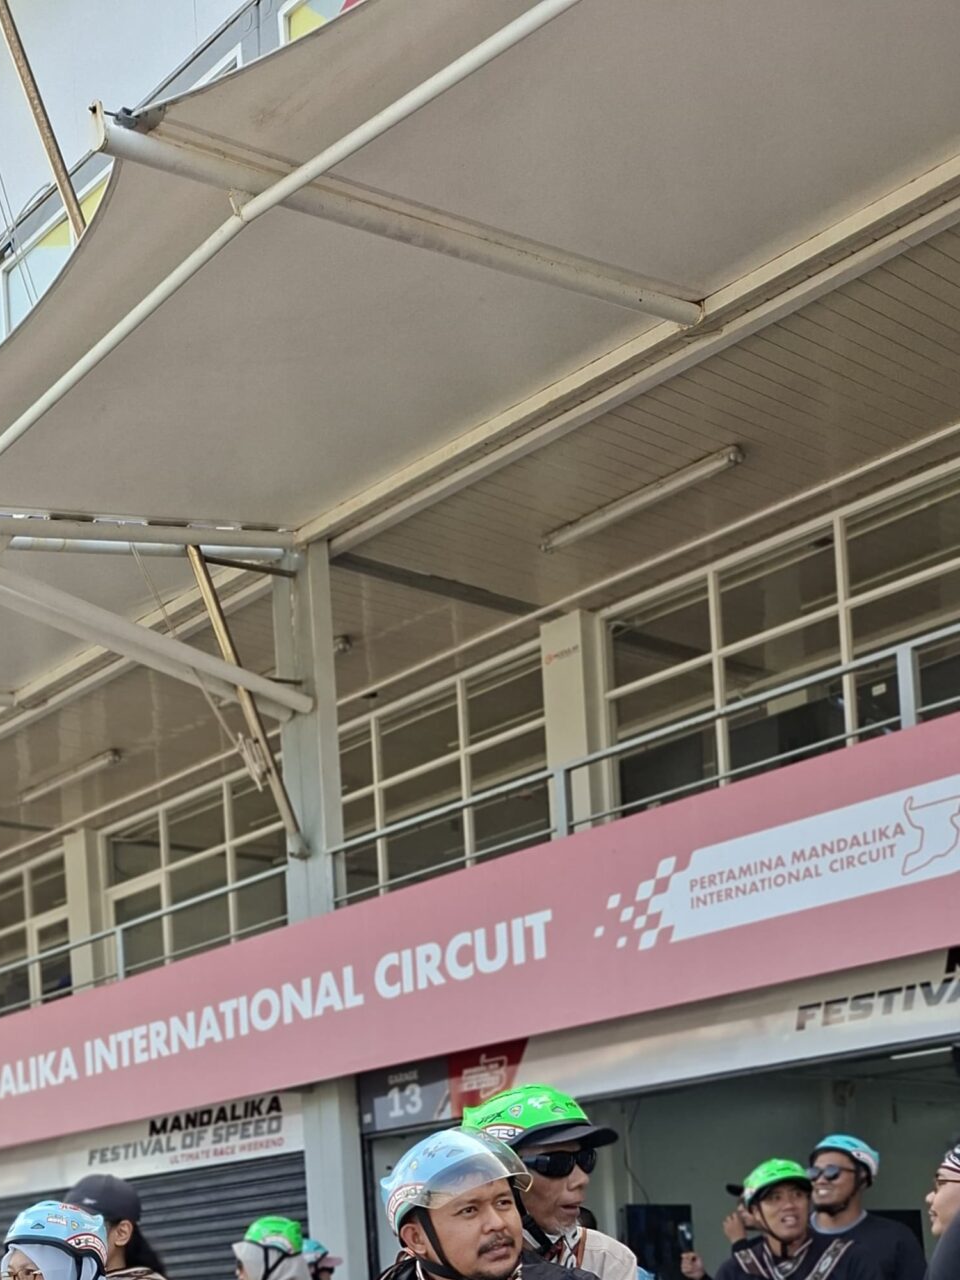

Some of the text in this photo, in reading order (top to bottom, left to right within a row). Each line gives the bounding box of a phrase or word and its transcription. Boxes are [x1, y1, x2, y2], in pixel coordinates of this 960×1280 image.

[689, 822, 906, 892] PERTAMINA MANDALIKA
[689, 844, 897, 910] INTERNATIONAL CIRCUIT
[84, 965, 365, 1077] INTERNATIONAL
[374, 909, 553, 999] CIRCUIT
[148, 1095, 283, 1137] MANDALIKA
[387, 1083, 423, 1118] 13
[88, 1115, 283, 1166] FESTIVAL OF SPEED
[169, 1137, 285, 1166] ULTIMATE RACE WEEKEND
